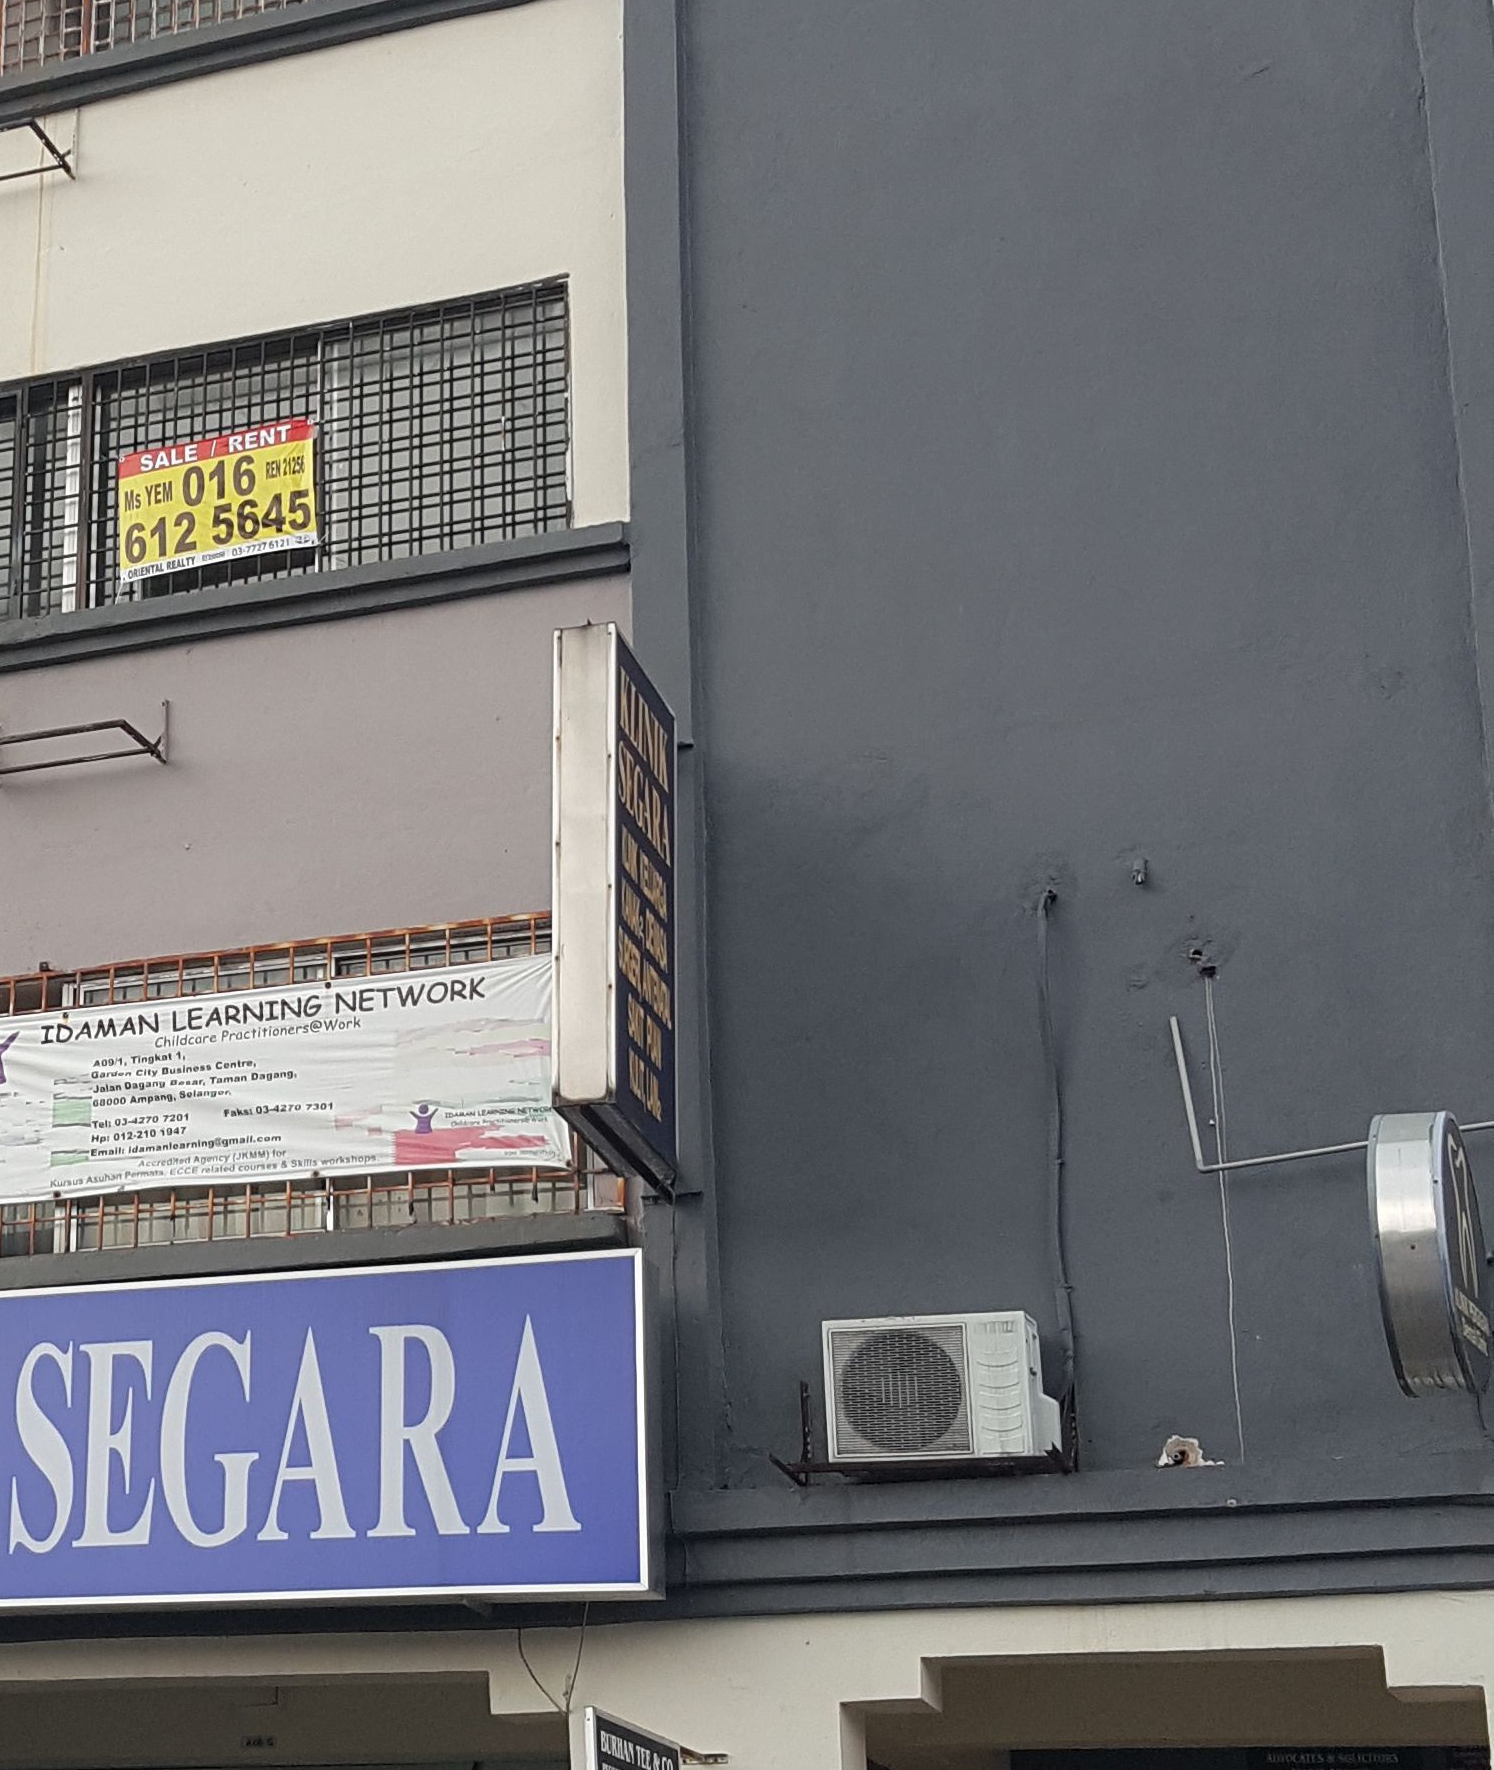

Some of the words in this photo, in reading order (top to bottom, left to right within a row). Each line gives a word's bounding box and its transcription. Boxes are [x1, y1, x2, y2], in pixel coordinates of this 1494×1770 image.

[140, 444, 198, 472] SALE
[228, 425, 291, 453] RENT
[124, 490, 141, 512] Ms
[145, 480, 173, 507] YEM
[182, 454, 256, 507] 016
[266, 460, 281, 480] REN
[124, 511, 197, 564] 612
[212, 489, 311, 545] 5645
[127, 562, 164, 580] ORIENTAL
[167, 556, 196, 570] REALTY
[620, 665, 668, 793] KLINIK
[619, 741, 671, 867] SEGARA
[39, 1012, 160, 1046] IDAMAN
[172, 995, 322, 1032] LEARNING
[334, 977, 486, 1014] NETWORK
[154, 1033, 217, 1049] Childcare
[221, 1017, 362, 1043] Practitioners@Work
[131, 1053, 172, 1066] Tingkat
[136, 1068, 158, 1079] City
[162, 1063, 211, 1076] Business
[92, 1083, 122, 1094] Jalan
[124, 1079, 166, 1092] Dagang
[209, 1074, 247, 1085] Taman
[130, 1092, 177, 1106] Ampang,
[162, 1113, 189, 1123] 7201
[223, 1107, 253, 1118] Faks:
[305, 1102, 334, 1112] 7301
[90, 1145, 125, 1157] Email:
[138, 1156, 191, 1168] Accredited
[193, 1153, 230, 1165] Agency
[272, 1148, 287, 1158] for
[50, 1177, 83, 1188] Kursus
[201, 1163, 236, 1174] related
[238, 1161, 277, 1173] courses
[8, 1314, 582, 1555] SEGARA
[600, 1730, 635, 1765] BURHAN
[636, 1745, 651, 1770] TEE
